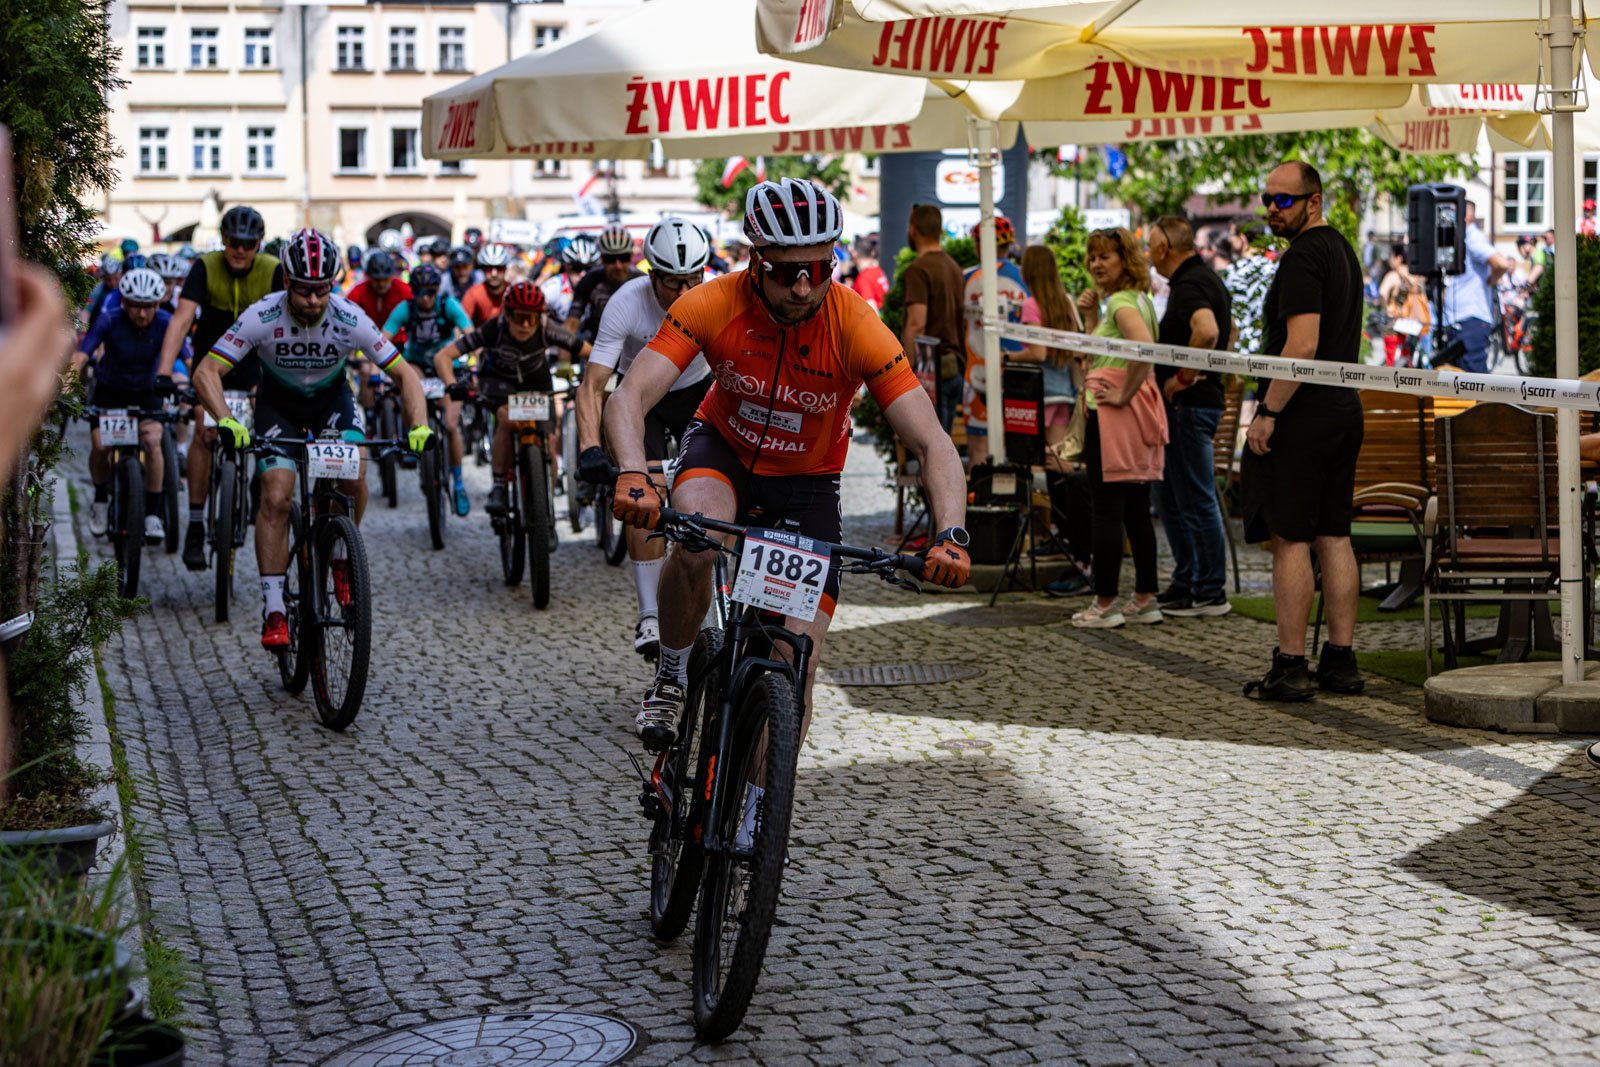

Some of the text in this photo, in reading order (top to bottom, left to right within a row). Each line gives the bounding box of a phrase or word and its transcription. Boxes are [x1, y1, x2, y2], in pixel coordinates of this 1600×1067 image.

[625, 72, 790, 135] ŻYWIEC
[275, 342, 339, 357] BORA
[1252, 361, 1268, 371] SCOTT
[1296, 367, 1315, 376] SCOTT
[1345, 371, 1366, 381] SCOTT
[1399, 376, 1422, 387] SCOTT
[1460, 381, 1486, 392] SCOTT
[1527, 386, 1557, 398] SCOTT
[802, 402, 837, 414] TEAM
[104, 418, 134, 431] 1721
[728, 416, 807, 452] BUDCHAL
[311, 445, 354, 459] 1437
[750, 544, 823, 588] 1882
